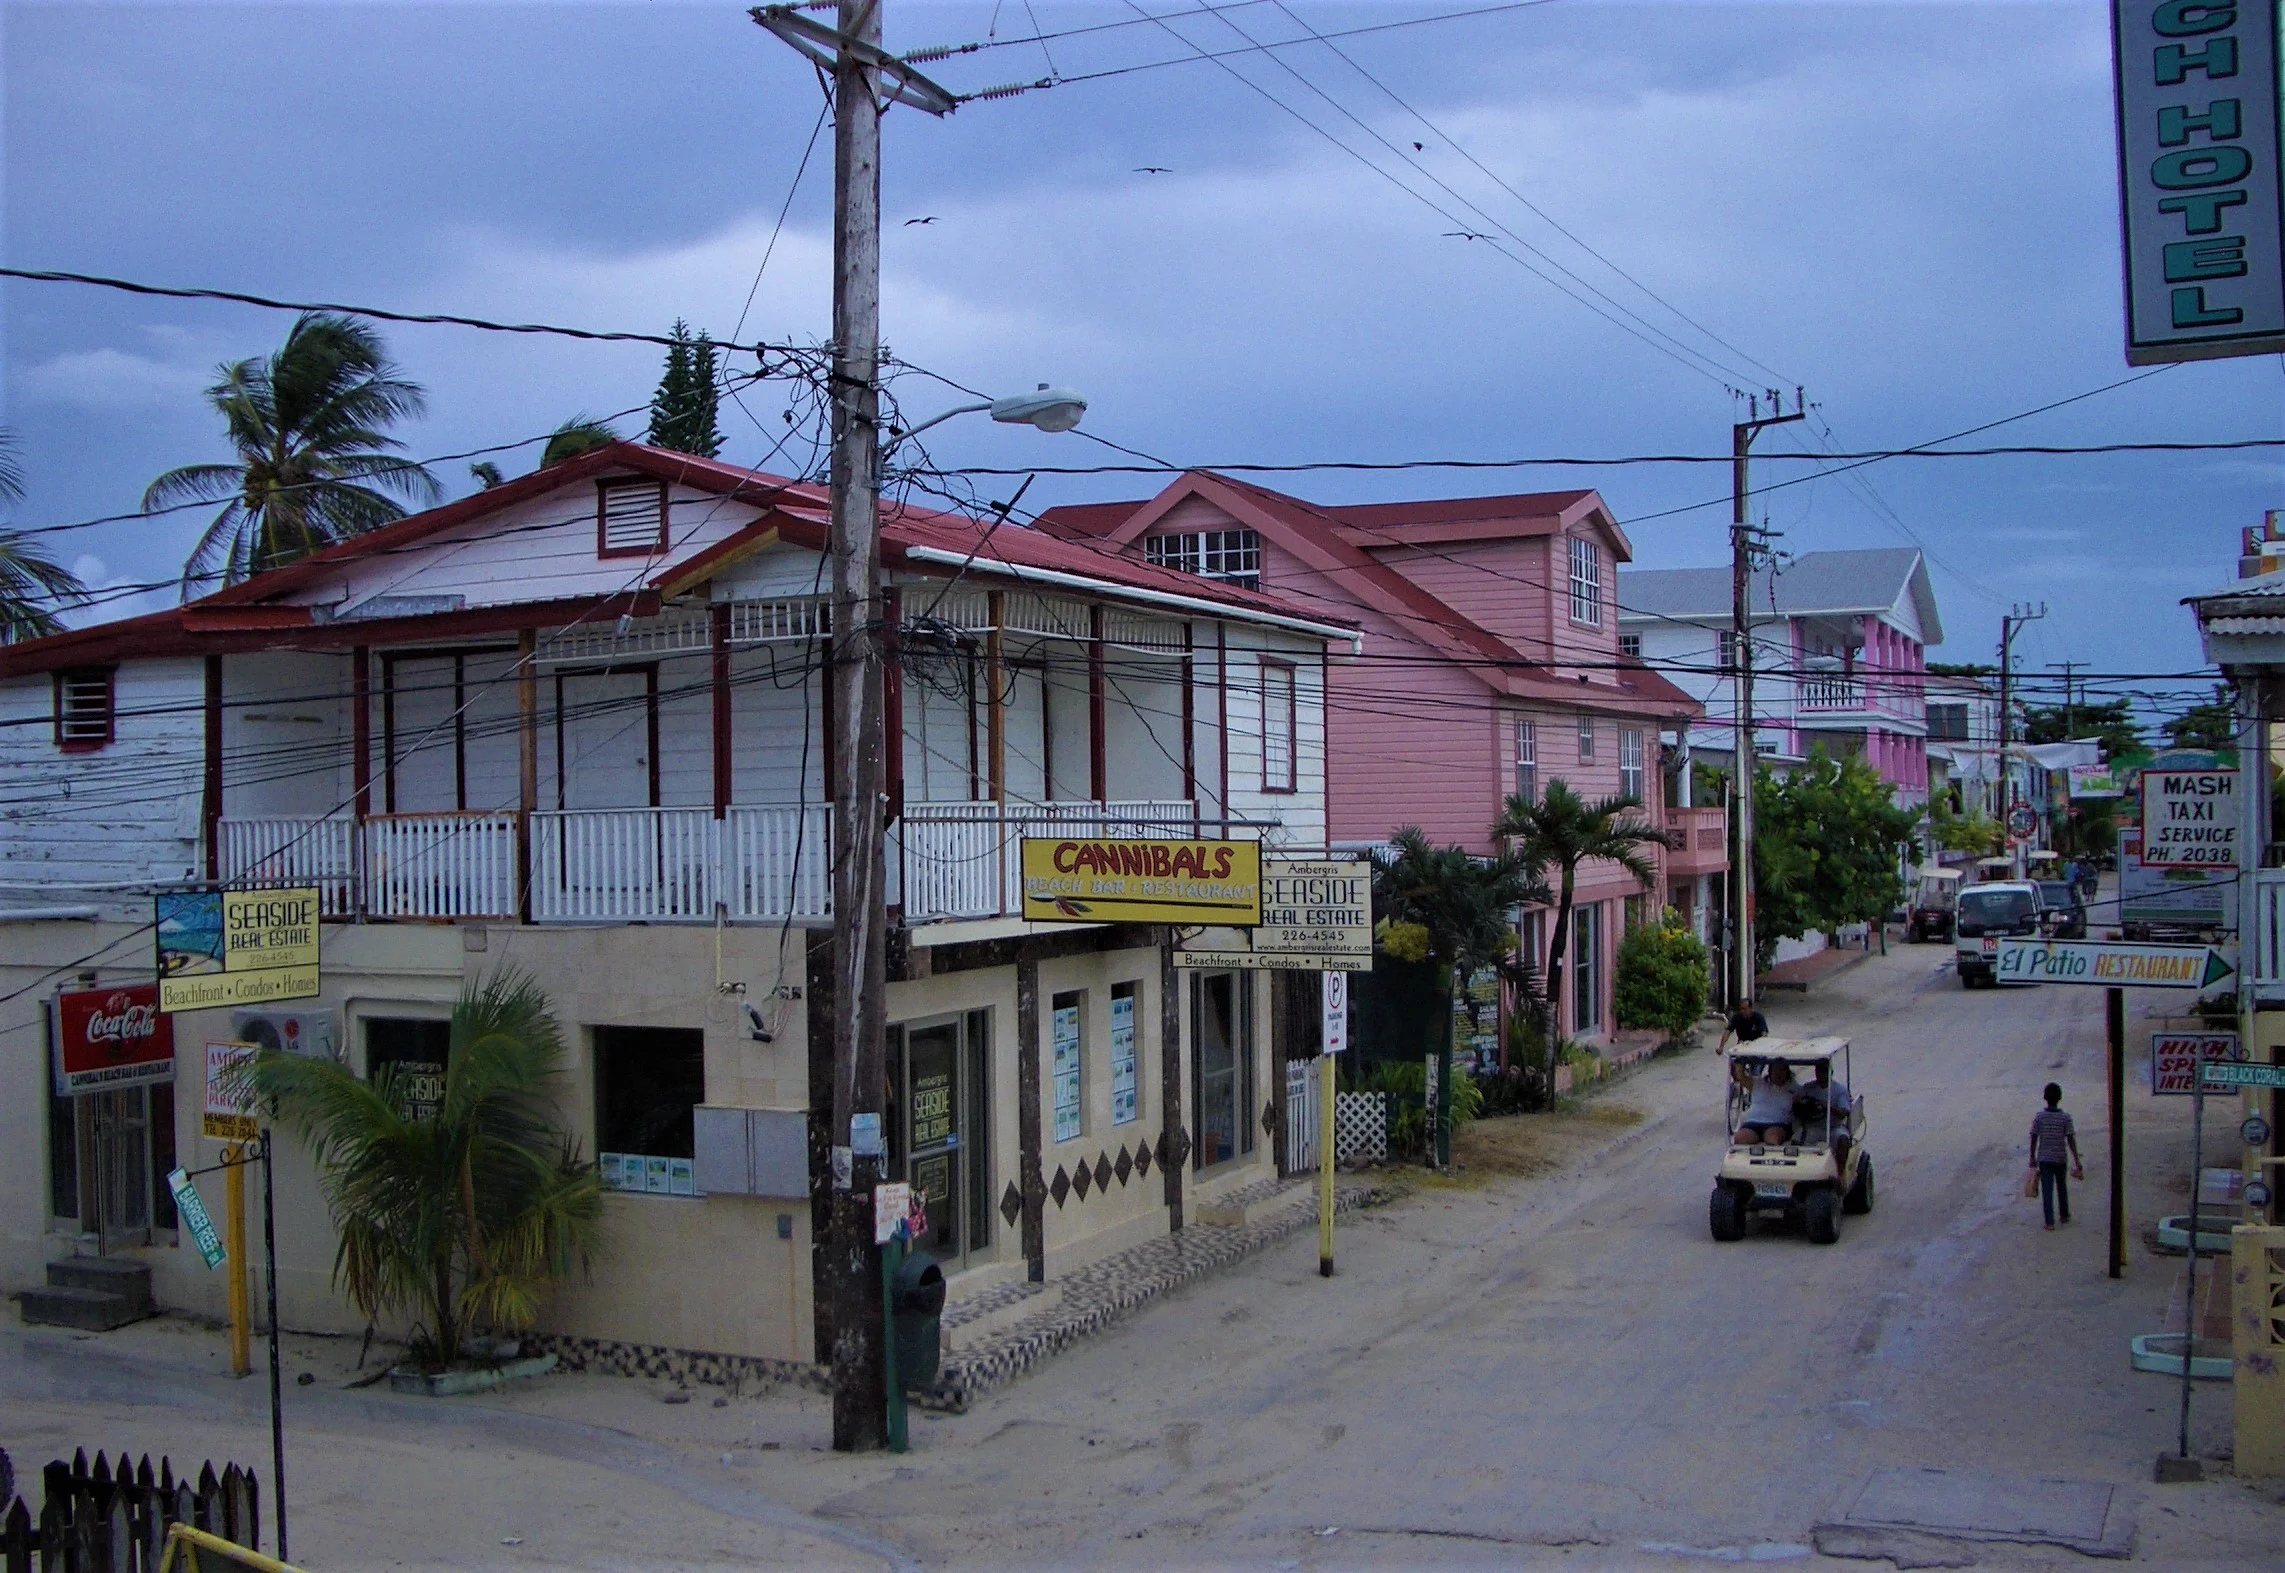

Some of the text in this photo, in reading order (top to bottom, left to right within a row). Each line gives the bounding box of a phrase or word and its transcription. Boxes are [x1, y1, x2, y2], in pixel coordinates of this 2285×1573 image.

[2151, 98, 2252, 329] HOTEL
[2163, 776, 2231, 795] MASH
[2168, 801, 2214, 820] TAXI
[2158, 827, 2236, 842] SERVICE
[2181, 847, 2231, 862] 2038
[1288, 863, 1338, 876] Ambergris
[1025, 877, 1258, 899] BEACH BAR RESTAURANT
[229, 900, 312, 930] SEASIDE
[1263, 910, 1365, 925] REAL ESTATE
[231, 928, 312, 950] REAL ESTATE
[1282, 930, 1345, 941] 226-4545
[1256, 942, 1371, 954] www.ambergrisrealestate.com
[1185, 954, 1361, 969] Beachfront Condos Homes
[2001, 949, 2203, 981] El Patio RESTAURANT
[164, 973, 316, 1006] Beachfront Condos Homes
[86, 1004, 156, 1043] Coca-Cola
[2229, 1067, 2255, 1083] BLACK
[2255, 1068, 2280, 1085] CORAL
[914, 1088, 950, 1120] SEASIDE
[179, 1186, 209, 1233] BARRIER
